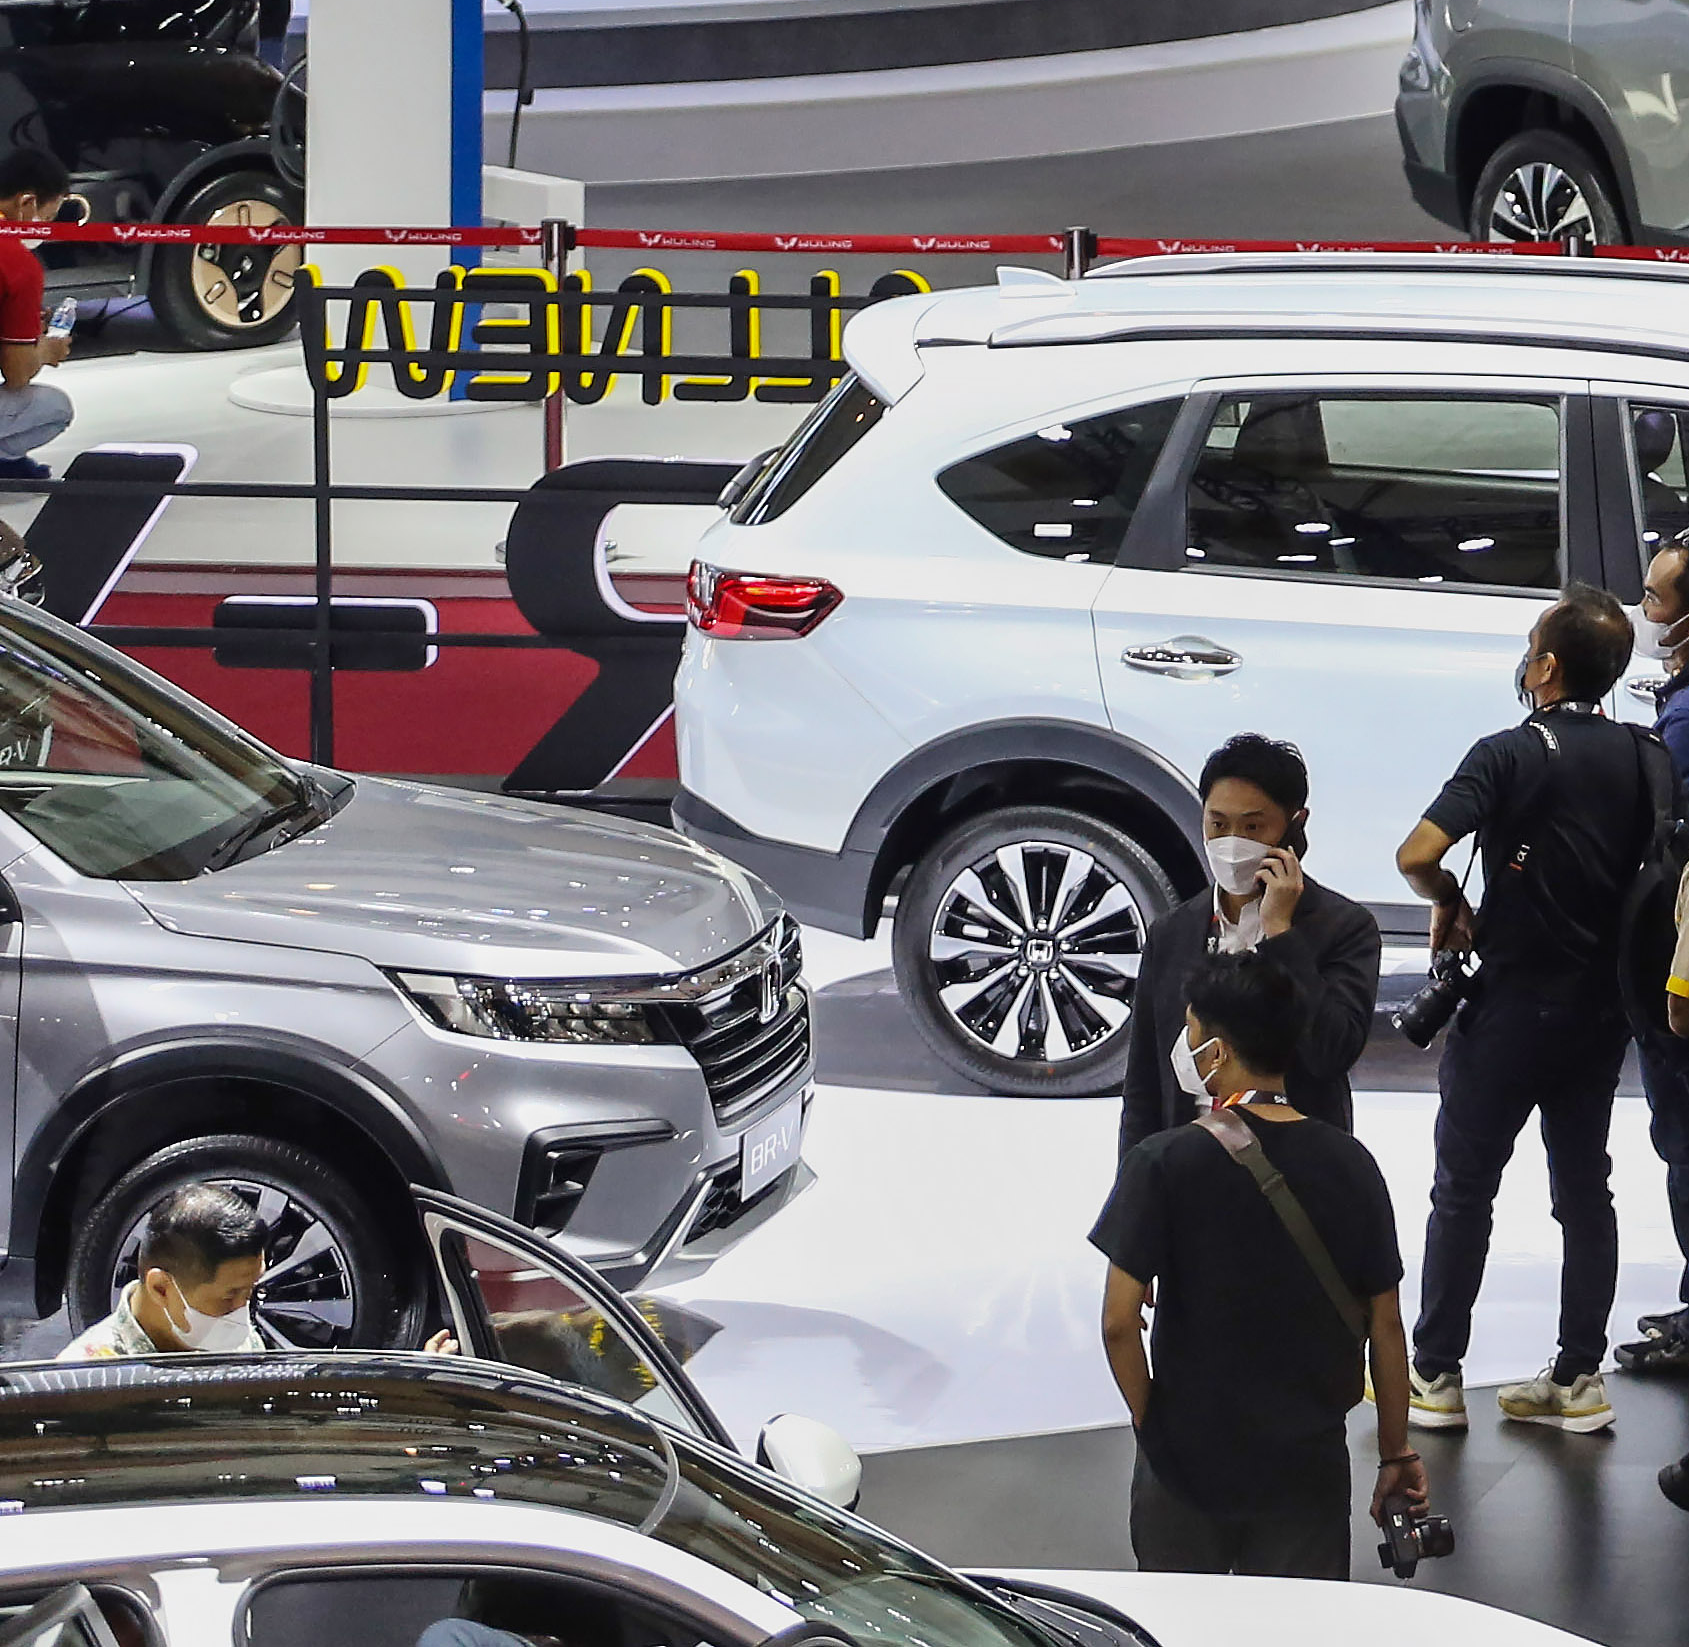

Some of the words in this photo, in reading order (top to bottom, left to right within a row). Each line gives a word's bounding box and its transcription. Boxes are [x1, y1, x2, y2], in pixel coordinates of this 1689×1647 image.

[136, 228, 192, 238] WULING
[269, 230, 326, 240] WULING
[407, 231, 462, 241] WULING
[661, 236, 717, 248] WULING
[796, 238, 852, 248] WULING
[936, 240, 991, 249] WULING
[751, 1119, 795, 1176] BR-V
